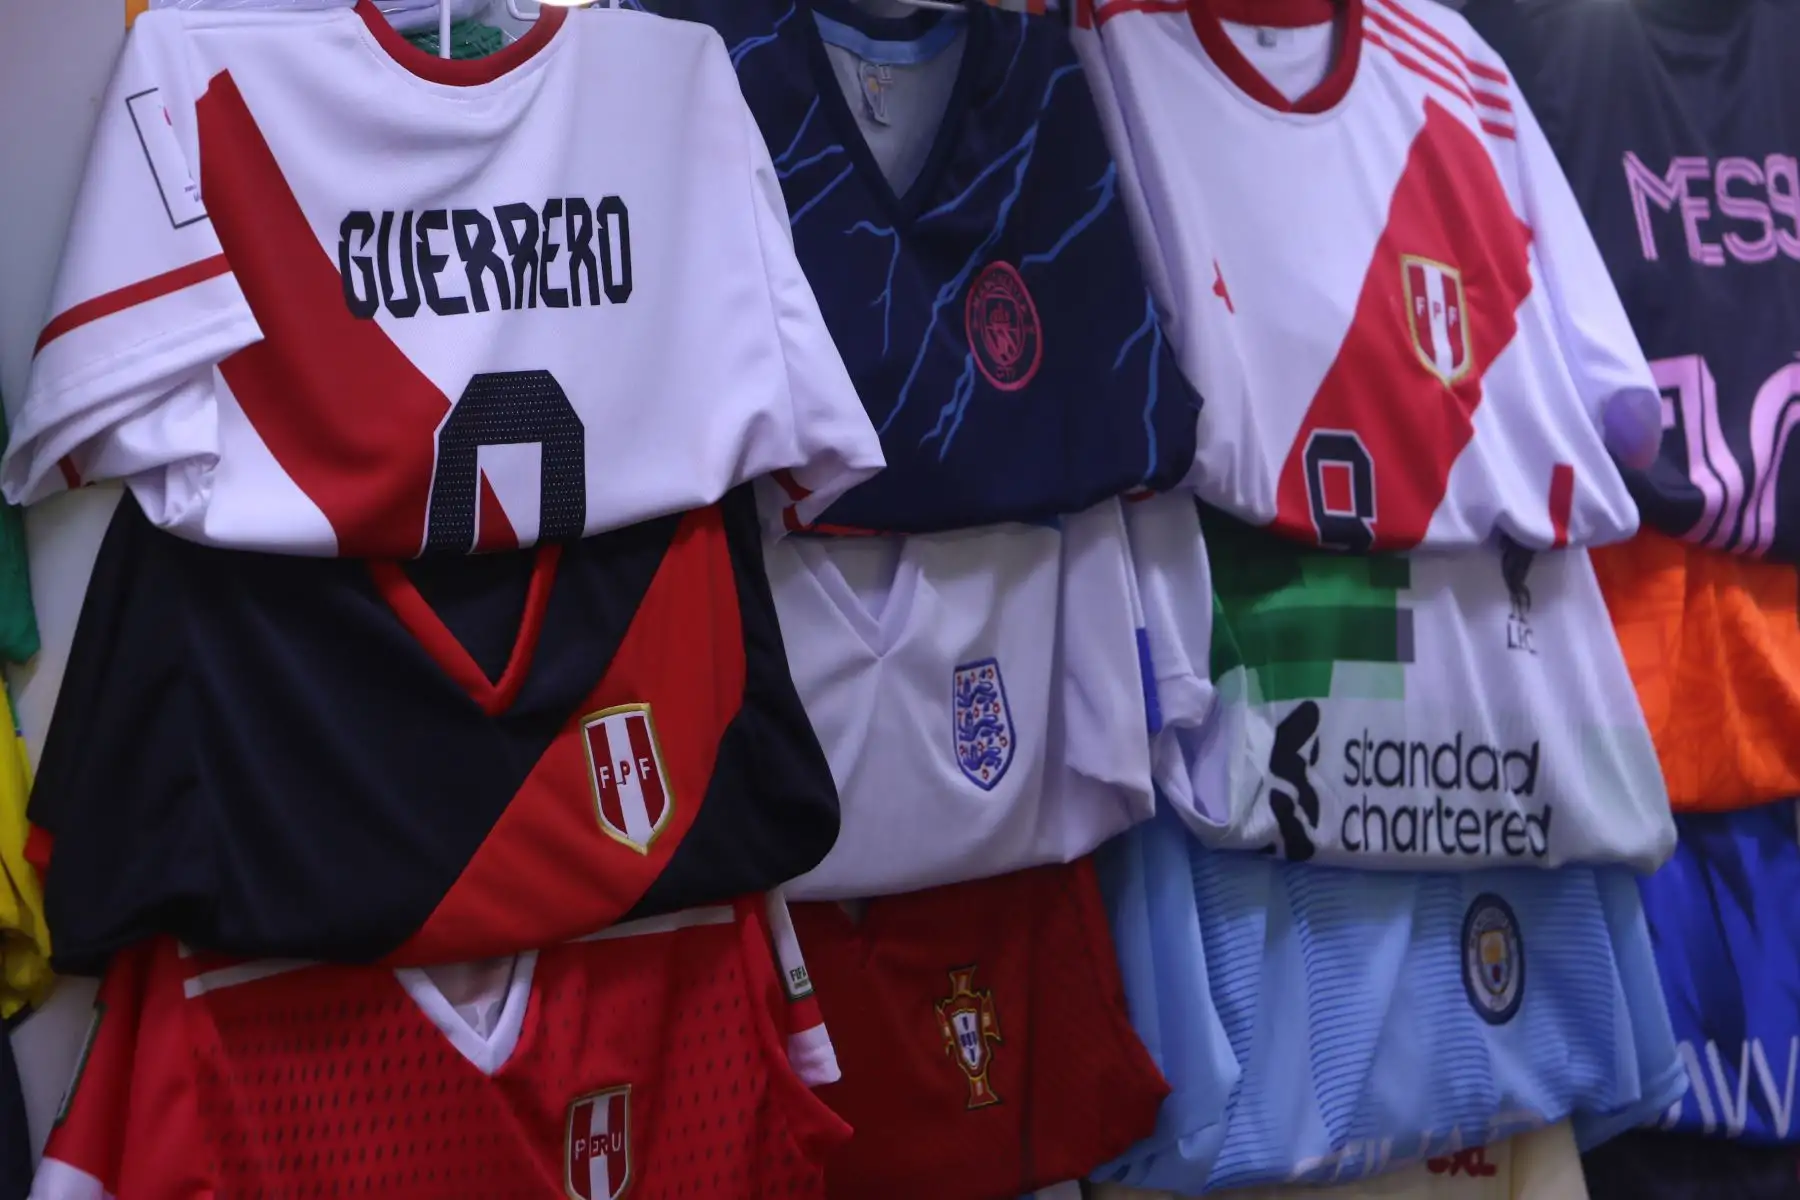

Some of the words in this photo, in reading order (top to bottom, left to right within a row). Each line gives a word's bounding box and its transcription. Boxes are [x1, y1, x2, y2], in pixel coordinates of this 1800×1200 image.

[338, 196, 632, 319] GUERRERO
[1415, 296, 1457, 328] FPF
[599, 757, 650, 789] FPF
[1341, 793, 1552, 857] chartered
[575, 1132, 622, 1160] PERU
